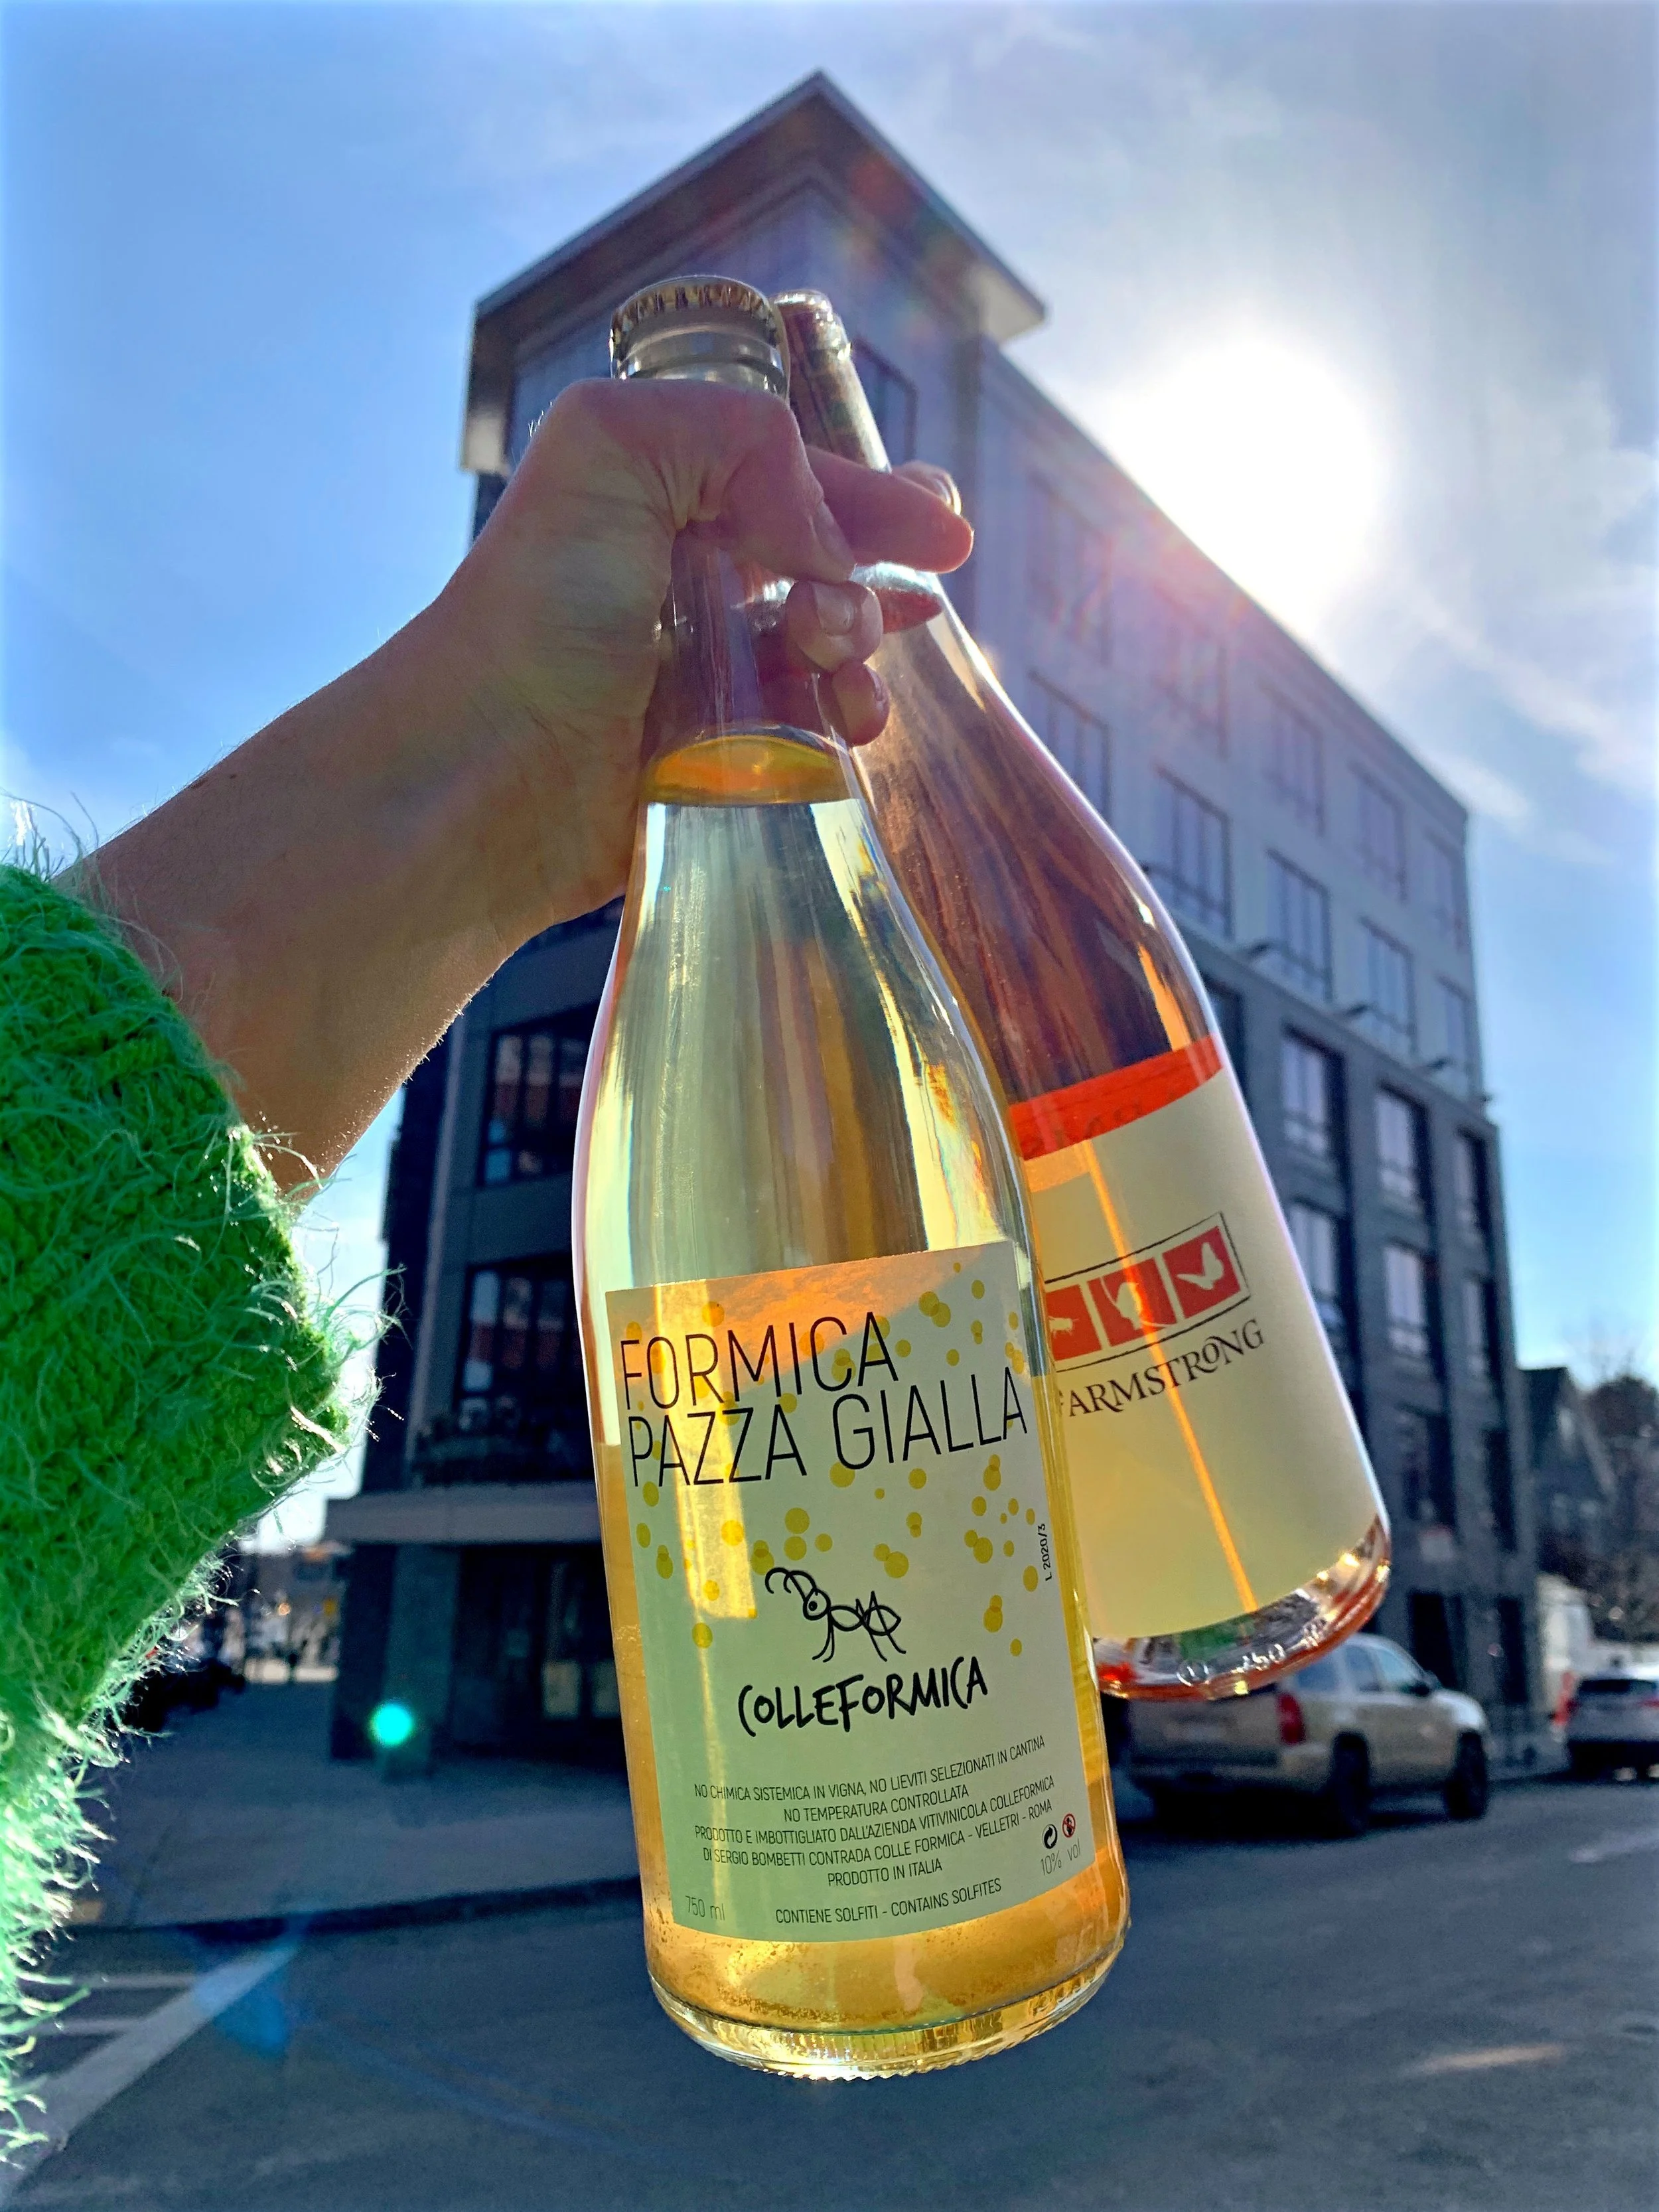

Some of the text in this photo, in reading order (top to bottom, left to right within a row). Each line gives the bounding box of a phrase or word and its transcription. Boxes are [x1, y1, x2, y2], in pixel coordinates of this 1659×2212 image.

[620, 1311, 899, 1410] FORMICA
[1060, 1318, 1264, 1417] ARMSTRONG
[628, 1366, 1028, 1487] PAZZA GIALLA
[1037, 1523, 1052, 1582] L 2020/3
[737, 1656, 988, 1737] COLLEFORMICA
[694, 1735, 1045, 1801] NO CHIMICA SISTEMICA IN VIGNA, NO LIEVITI SELEZIONATI IN CANTINA
[695, 1775, 1054, 1844] PRODOTTO E IMBOTTIGLIATO DALL'AZIENDA VITIVINICOLA COLLEFORMICA
[703, 1848, 712, 1861] DI
[714, 1849, 749, 1866] SERGIO
[752, 1852, 806, 1866] BOMBETTI
[808, 1848, 872, 1866] CONTRADA
[874, 1840, 912, 1860] COLLE
[914, 1830, 966, 1854] FORMICA
[975, 1812, 1020, 1839] VELLETRI
[1028, 1799, 1053, 1820] ROMA
[784, 1784, 969, 1822] NO TEMPERATURA CONTROLLATA
[828, 1858, 943, 1886] PRODOTTO IN ITALIA
[1040, 1837, 1081, 1876] 10% vol
[685, 1895, 725, 1921] 750 ml
[776, 1908, 832, 1923] CONTIENE
[835, 1905, 879, 1922] SOLFITI
[891, 1892, 949, 1917] CONTAINS
[952, 1878, 1001, 1905] SOLFITES
